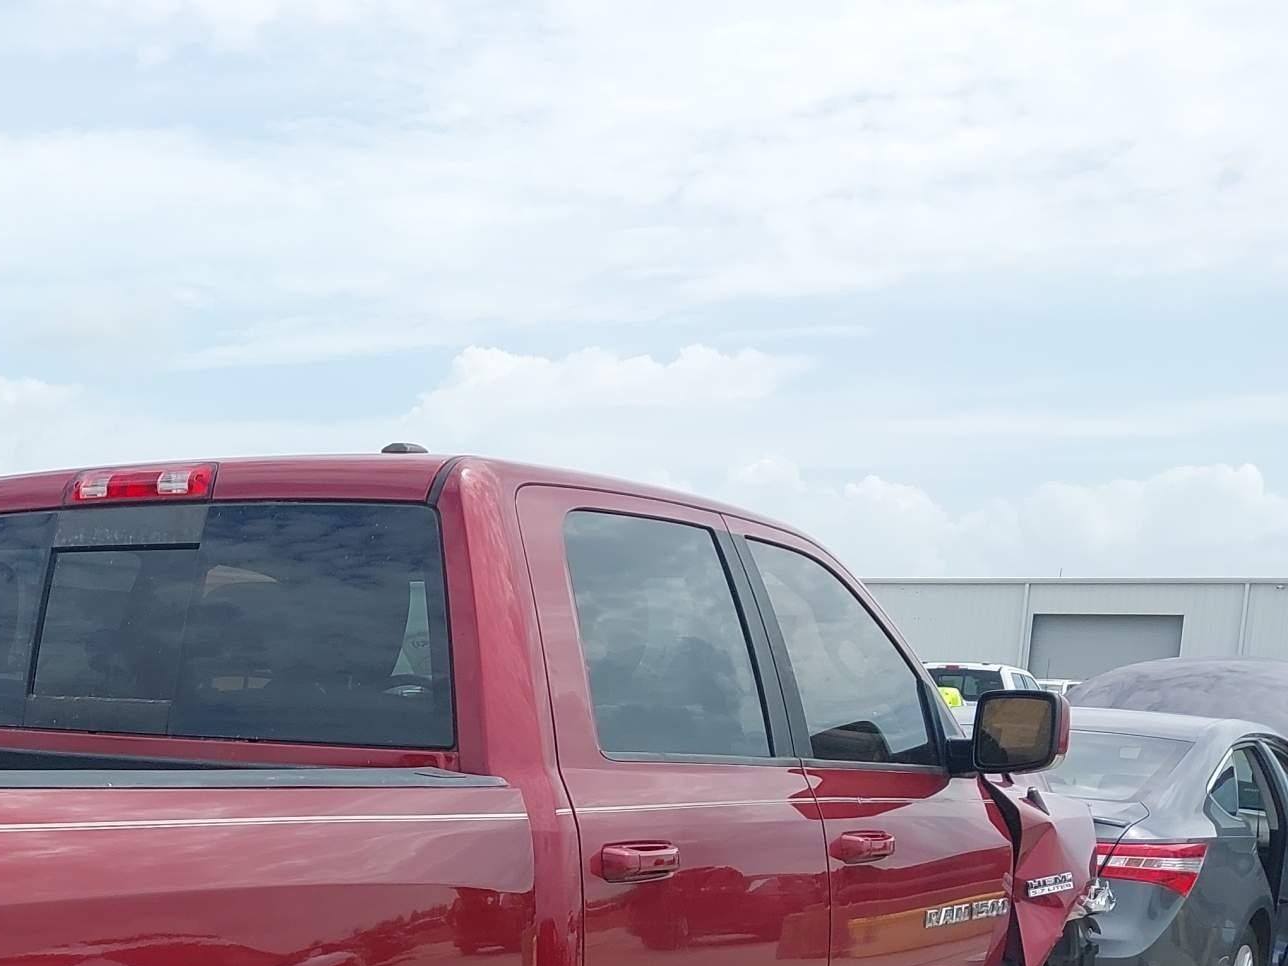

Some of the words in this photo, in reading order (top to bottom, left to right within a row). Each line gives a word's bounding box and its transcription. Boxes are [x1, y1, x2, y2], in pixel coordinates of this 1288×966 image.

[1046, 883, 1072, 895] LITER
[925, 903, 971, 929] RAM
[972, 898, 1009, 921] 1500
